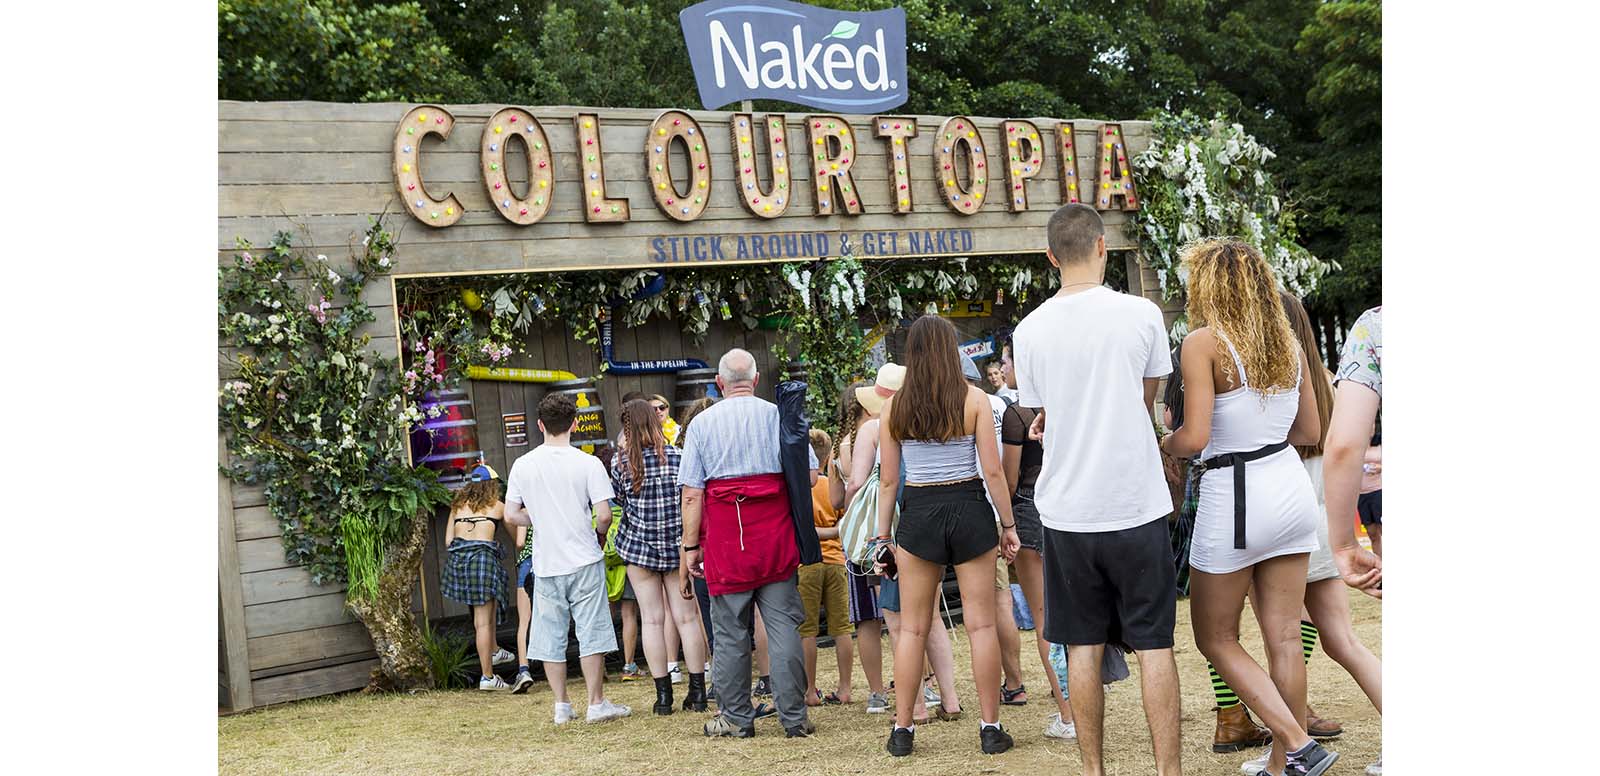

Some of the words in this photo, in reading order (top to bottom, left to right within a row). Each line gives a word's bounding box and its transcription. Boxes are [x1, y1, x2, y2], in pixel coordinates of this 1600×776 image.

[392, 105, 1139, 228] COLOURTOPIA
[652, 235, 724, 262] STICK
[736, 232, 830, 259] AROUND
[839, 233, 853, 254] &
[863, 231, 899, 255] GET
[908, 229, 973, 253] NAKED
[631, 362, 637, 370] IN
[640, 361, 655, 369] THE
[656, 360, 688, 369] PIPELINE
